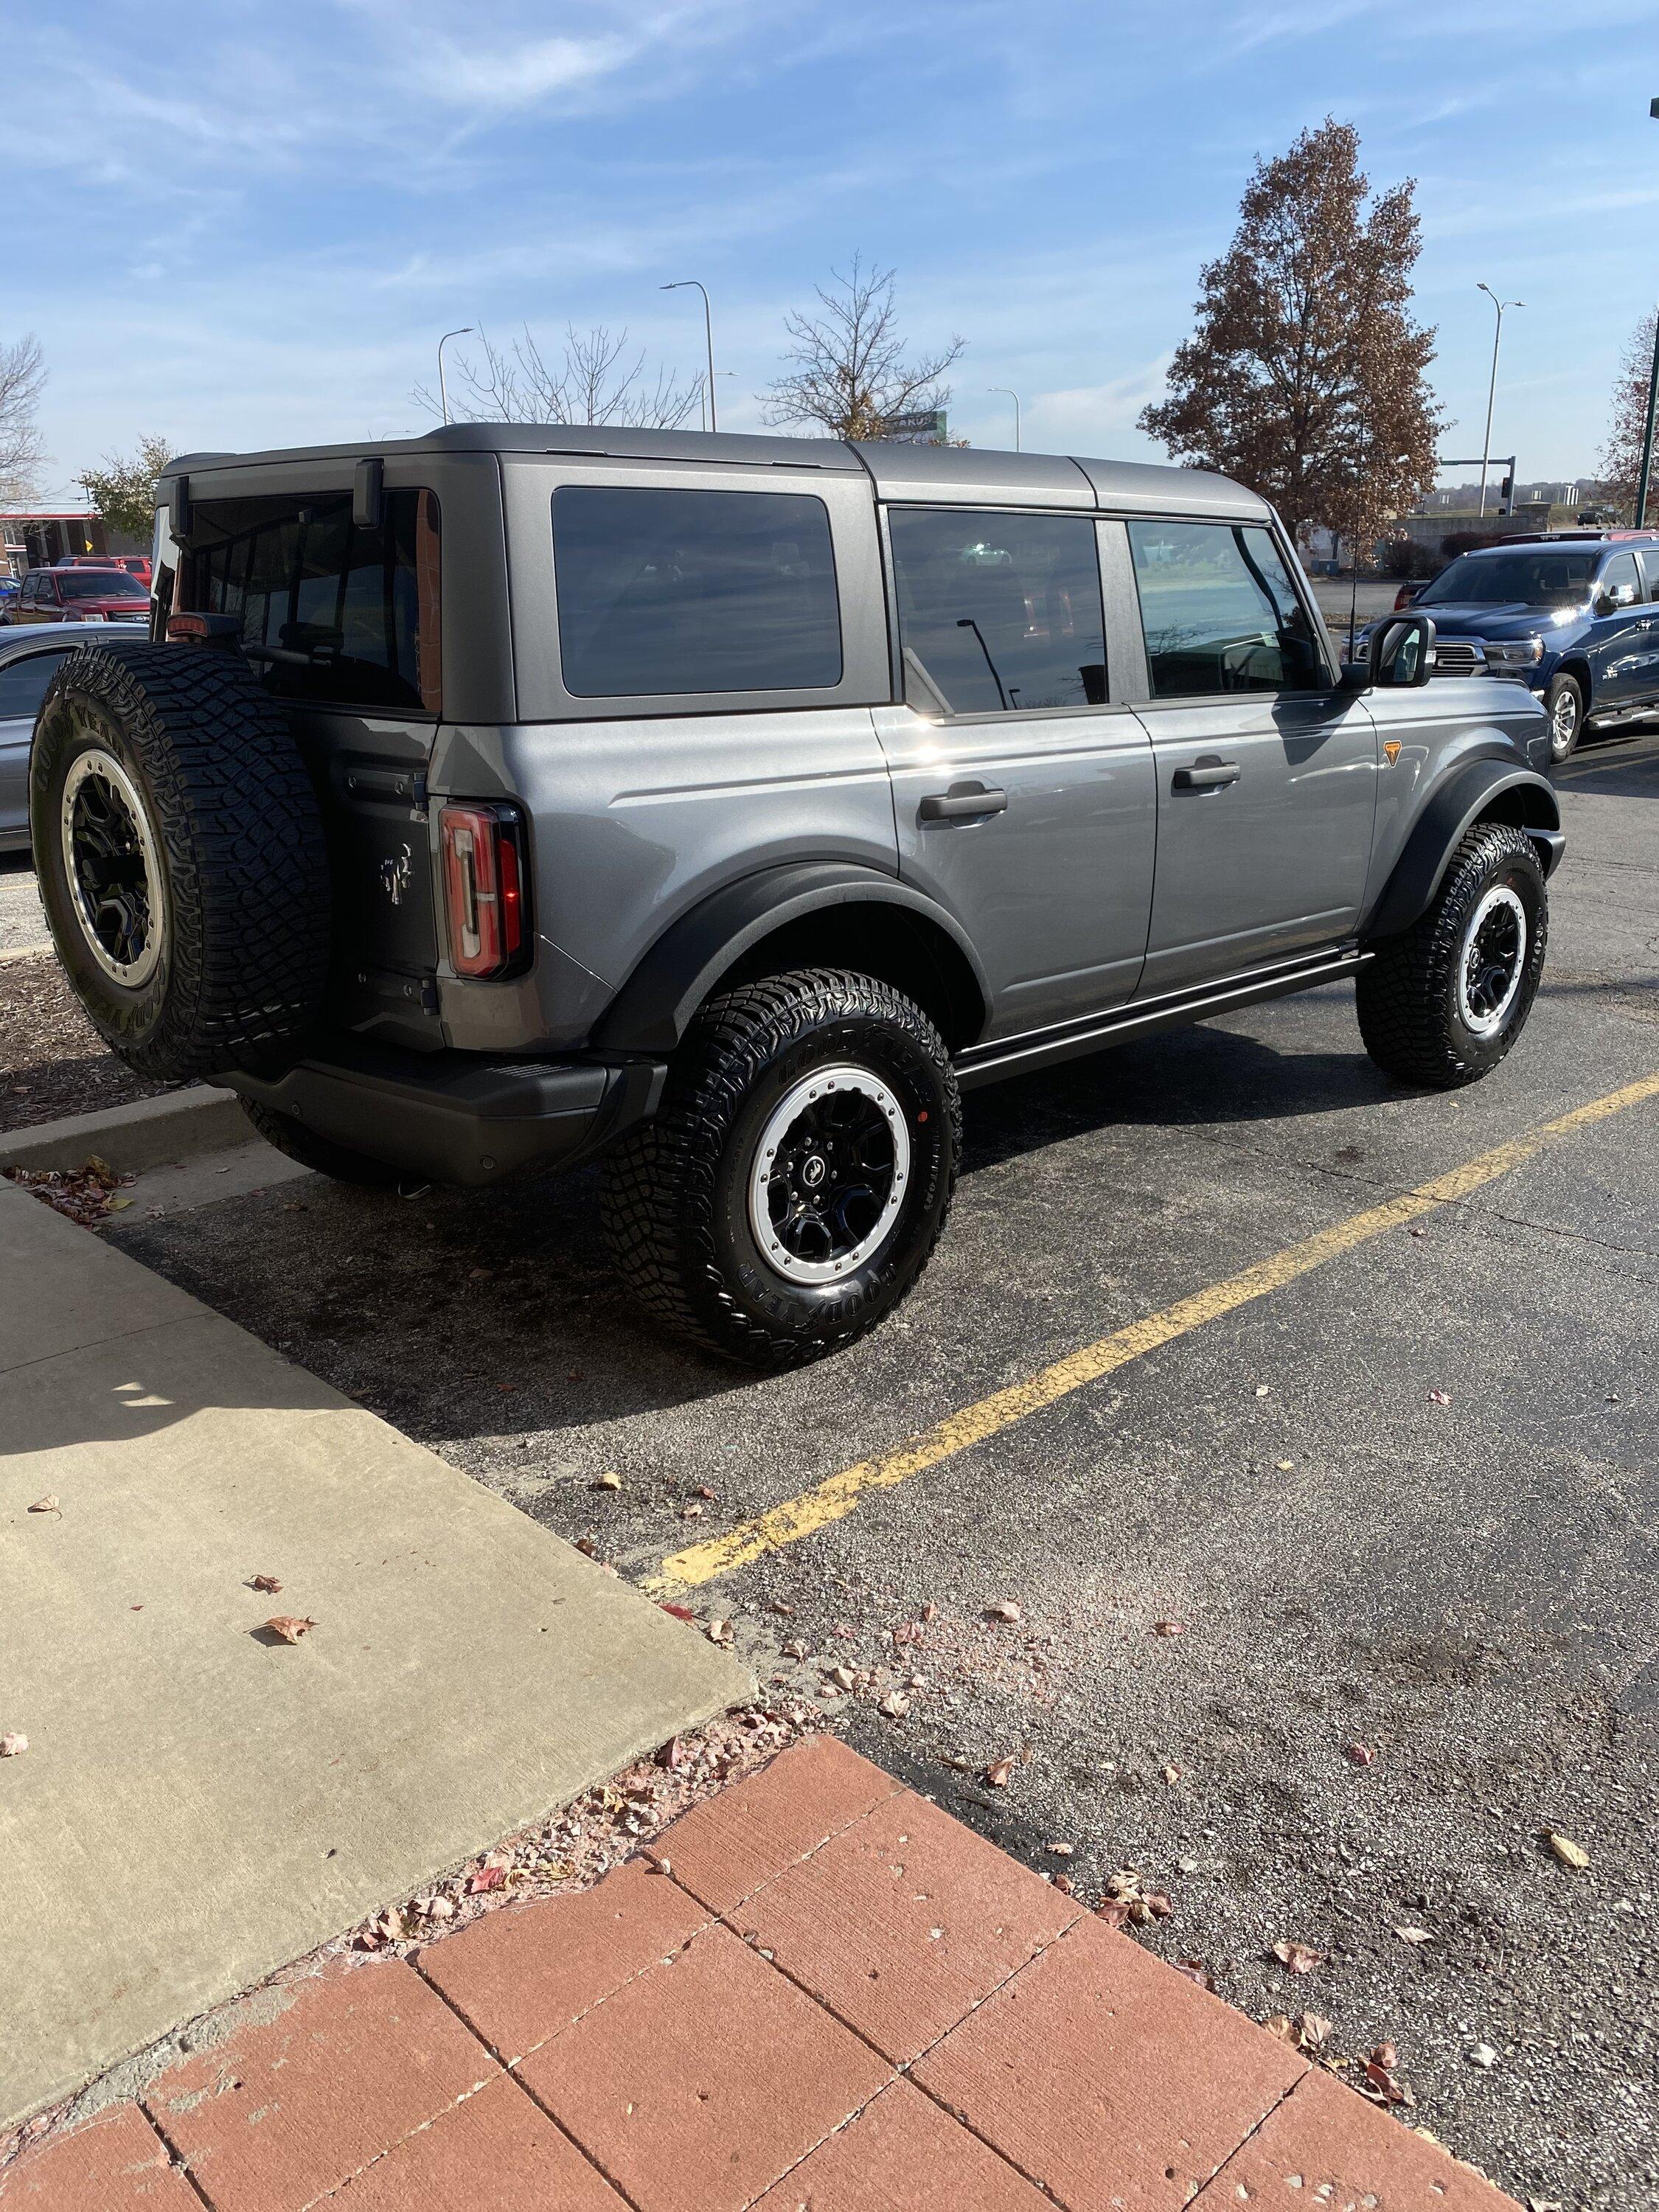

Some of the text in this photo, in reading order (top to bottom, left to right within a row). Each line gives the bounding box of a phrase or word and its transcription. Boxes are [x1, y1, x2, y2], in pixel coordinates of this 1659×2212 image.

[35, 699, 125, 792] GOODYEAR
[779, 1024, 936, 1104] GOODYEAR
[739, 1263, 897, 1334] GOODYEAR
